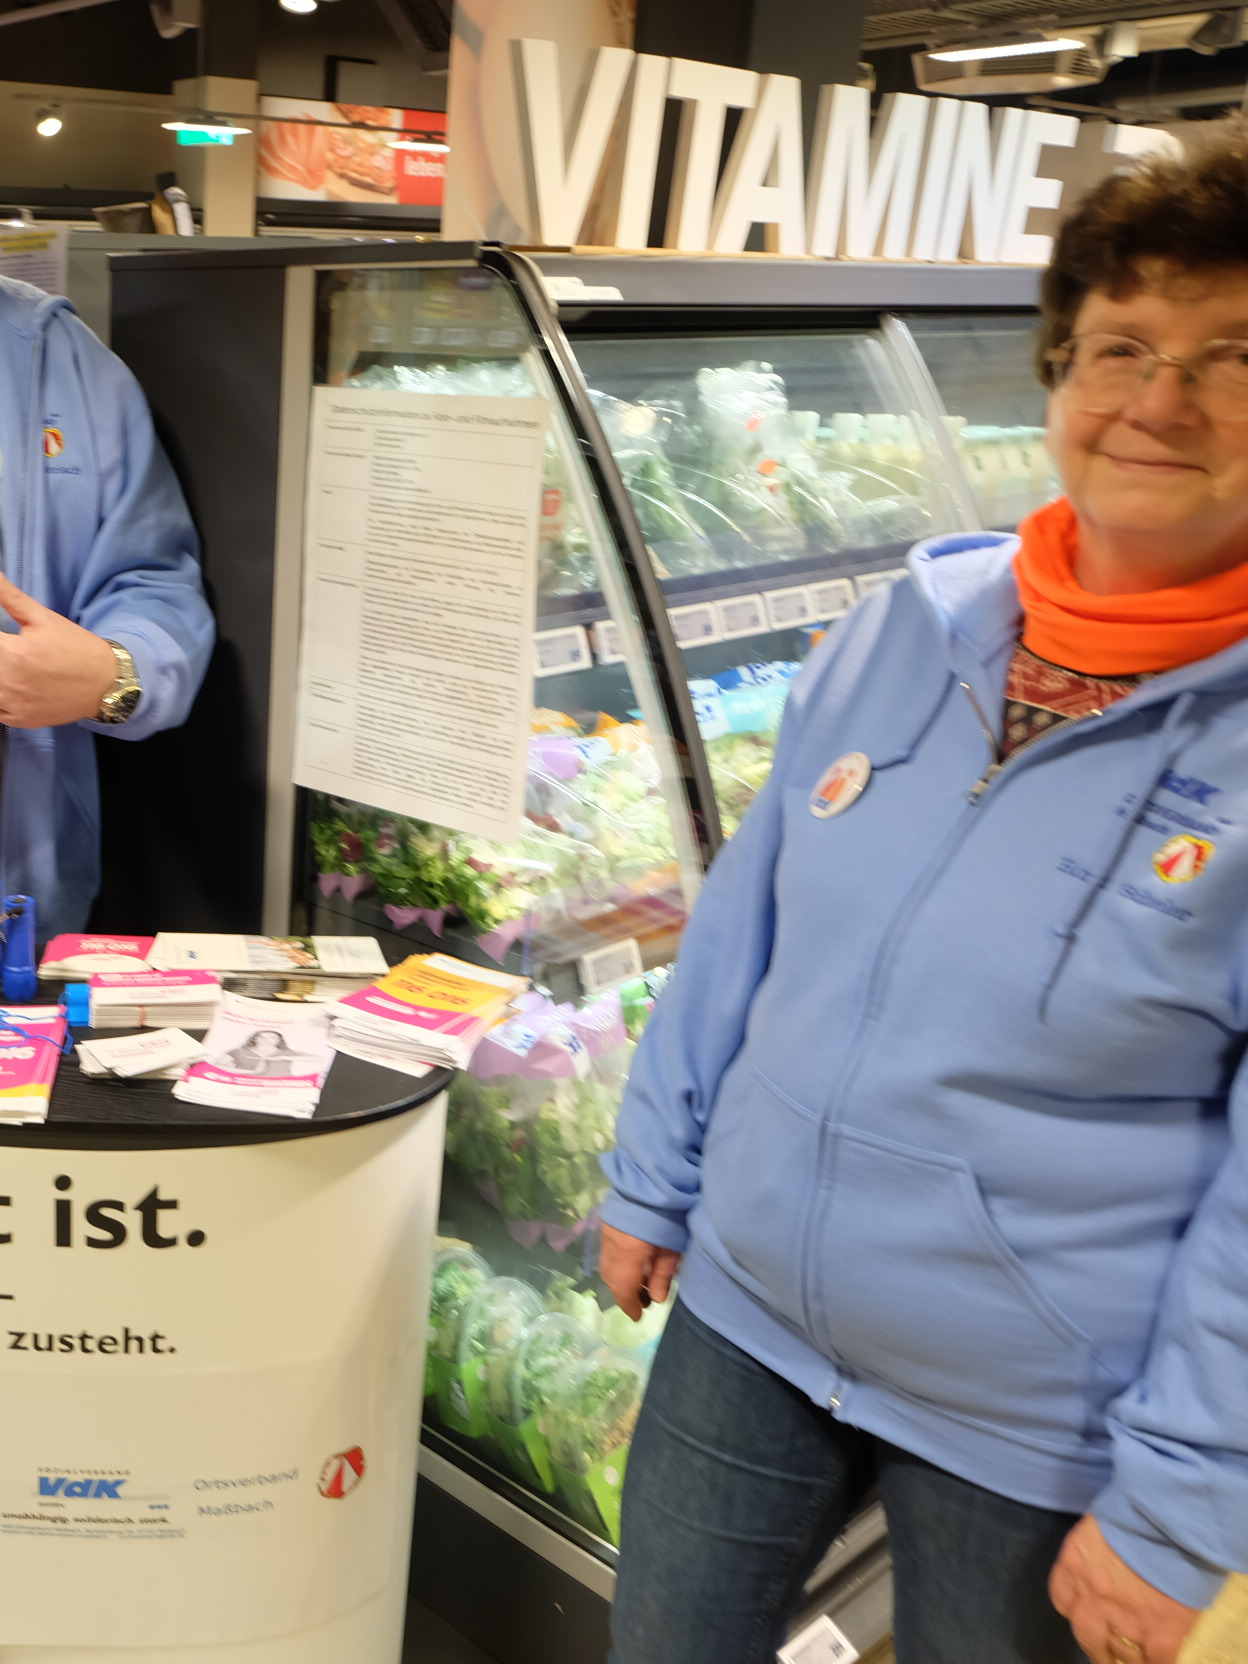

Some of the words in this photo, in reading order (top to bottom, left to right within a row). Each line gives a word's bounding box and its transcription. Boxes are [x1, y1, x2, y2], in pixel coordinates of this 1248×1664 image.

[512, 37, 1081, 266] VITAMINE
[51, 1173, 207, 1250] ist.
[7, 1326, 178, 1356] zusteht.
[37, 1475, 128, 1499] VdK
